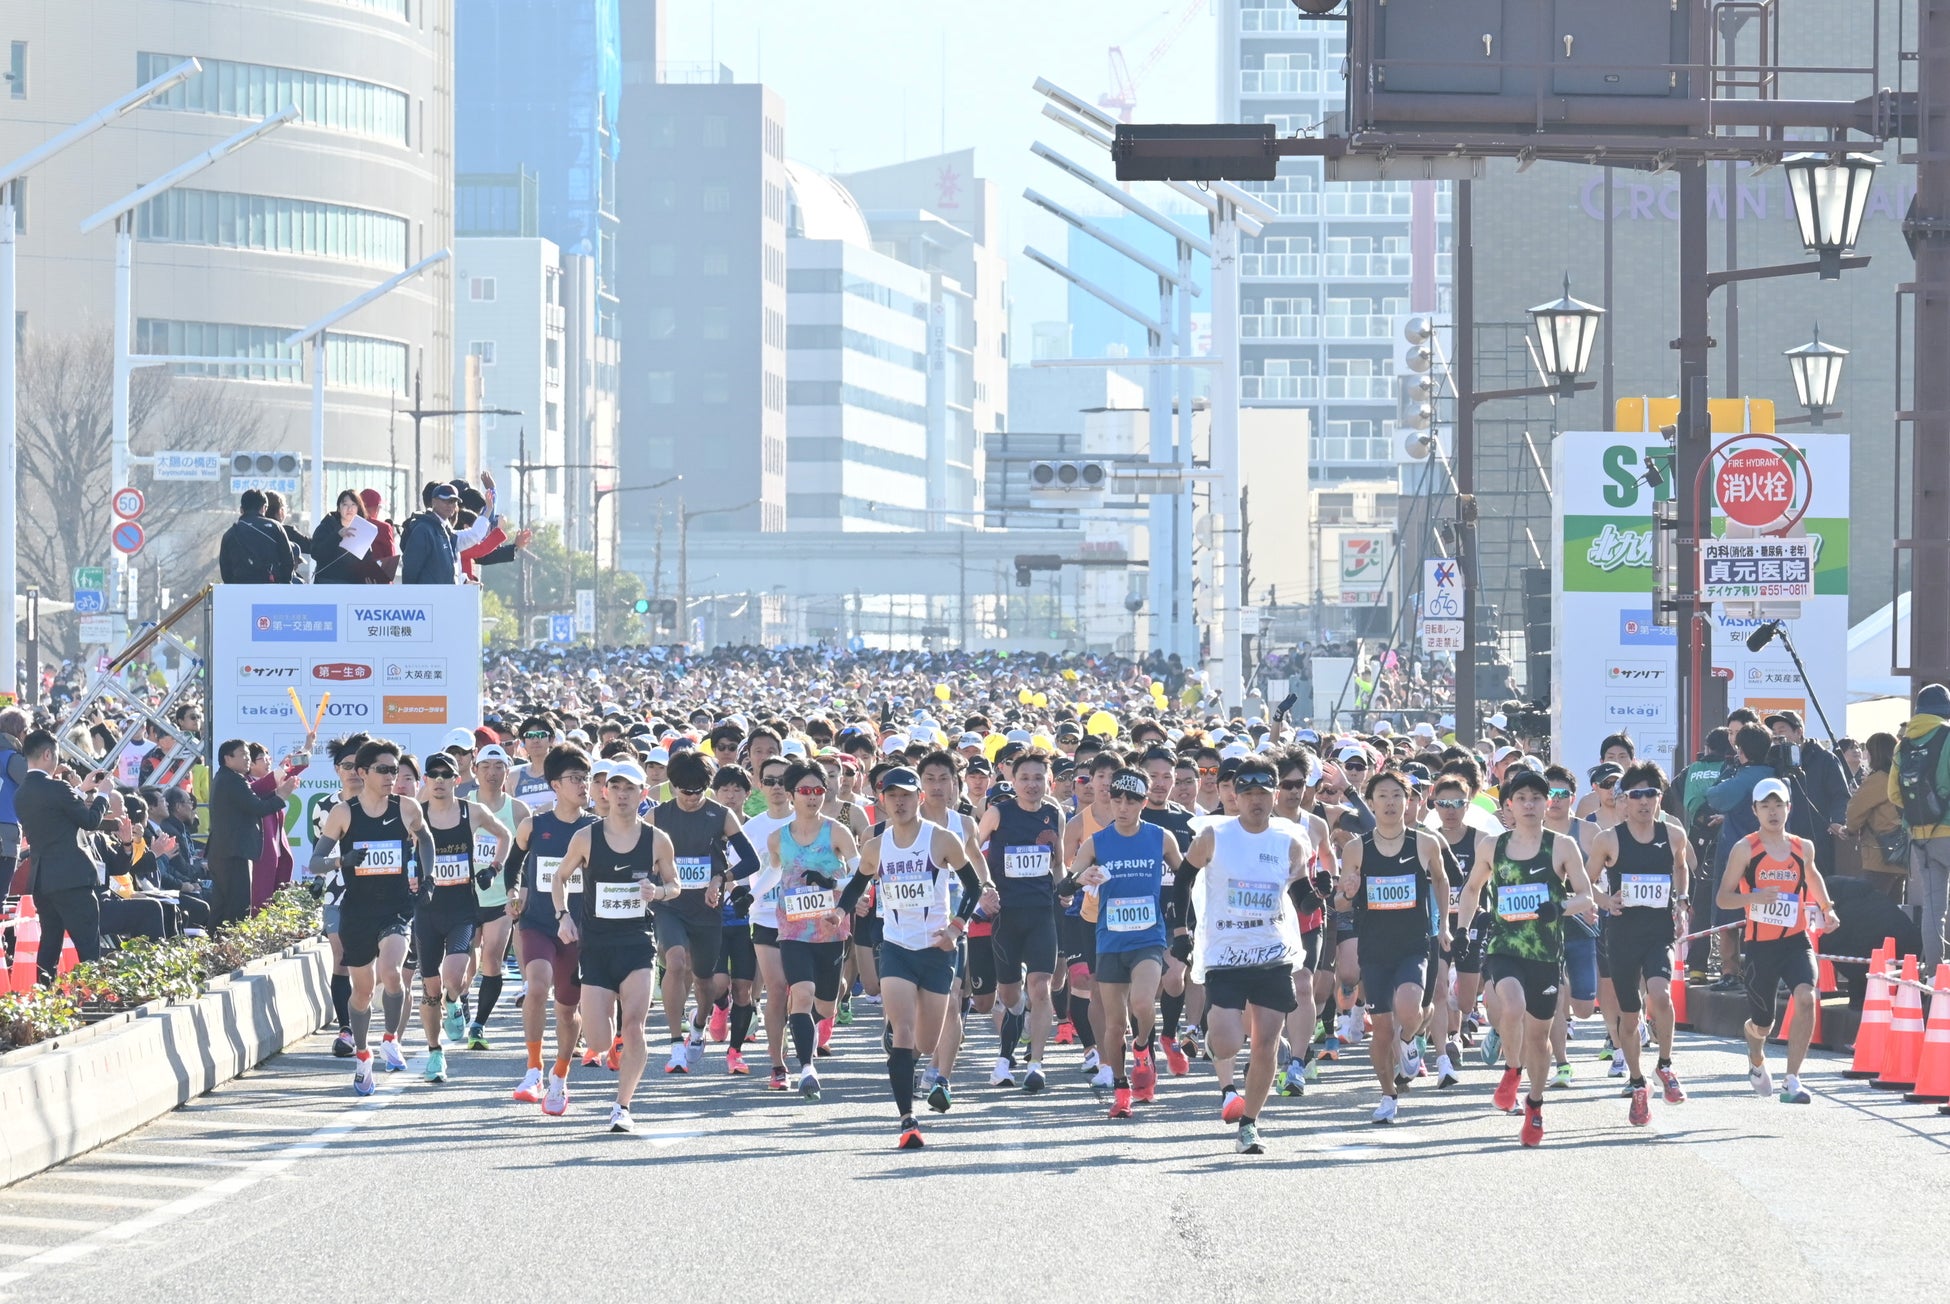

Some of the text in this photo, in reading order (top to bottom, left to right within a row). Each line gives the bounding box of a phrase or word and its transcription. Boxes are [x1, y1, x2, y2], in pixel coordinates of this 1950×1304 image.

[1728, 458, 1779, 468] FIRE HYDRANT
[1722, 471, 1788, 503] 消火栓
[119, 496, 137, 512] 50
[1708, 560, 1806, 582] 貞元医院
[1707, 584, 1807, 596] デイケア有り 551-0811
[354, 609, 426, 621] YASKAWA
[272, 621, 333, 632] 第一交通産業
[367, 626, 412, 637] 安川電機
[1425, 624, 1461, 634] 自転車レーン
[1427, 638, 1459, 647] 逆走禁止
[253, 668, 299, 677] サンリブ
[319, 666, 366, 678] 第一生命
[405, 670, 443, 680] 大英産業
[1621, 670, 1665, 679] サンリブ
[1765, 674, 1801, 683] 大英産業
[242, 705, 293, 717] takagi
[1609, 705, 1659, 717] takagi
[1122, 774, 1137, 782] THE
[1690, 770, 1721, 782] PRES
[366, 851, 394, 866] 1005
[1016, 854, 1042, 869] 1017
[434, 863, 460, 878] 1001
[679, 866, 705, 880] 0065
[886, 859, 924, 875] 福岡県庁
[894, 883, 925, 899] 1064
[1376, 885, 1410, 900] 10005
[1634, 884, 1662, 899] 1018
[602, 899, 641, 910] 塚本秀志
[796, 893, 826, 911] 1002
[1237, 890, 1273, 908] 10446
[1506, 894, 1541, 912] 10001
[1115, 906, 1149, 922] 10010
[1763, 902, 1791, 917] 1020
